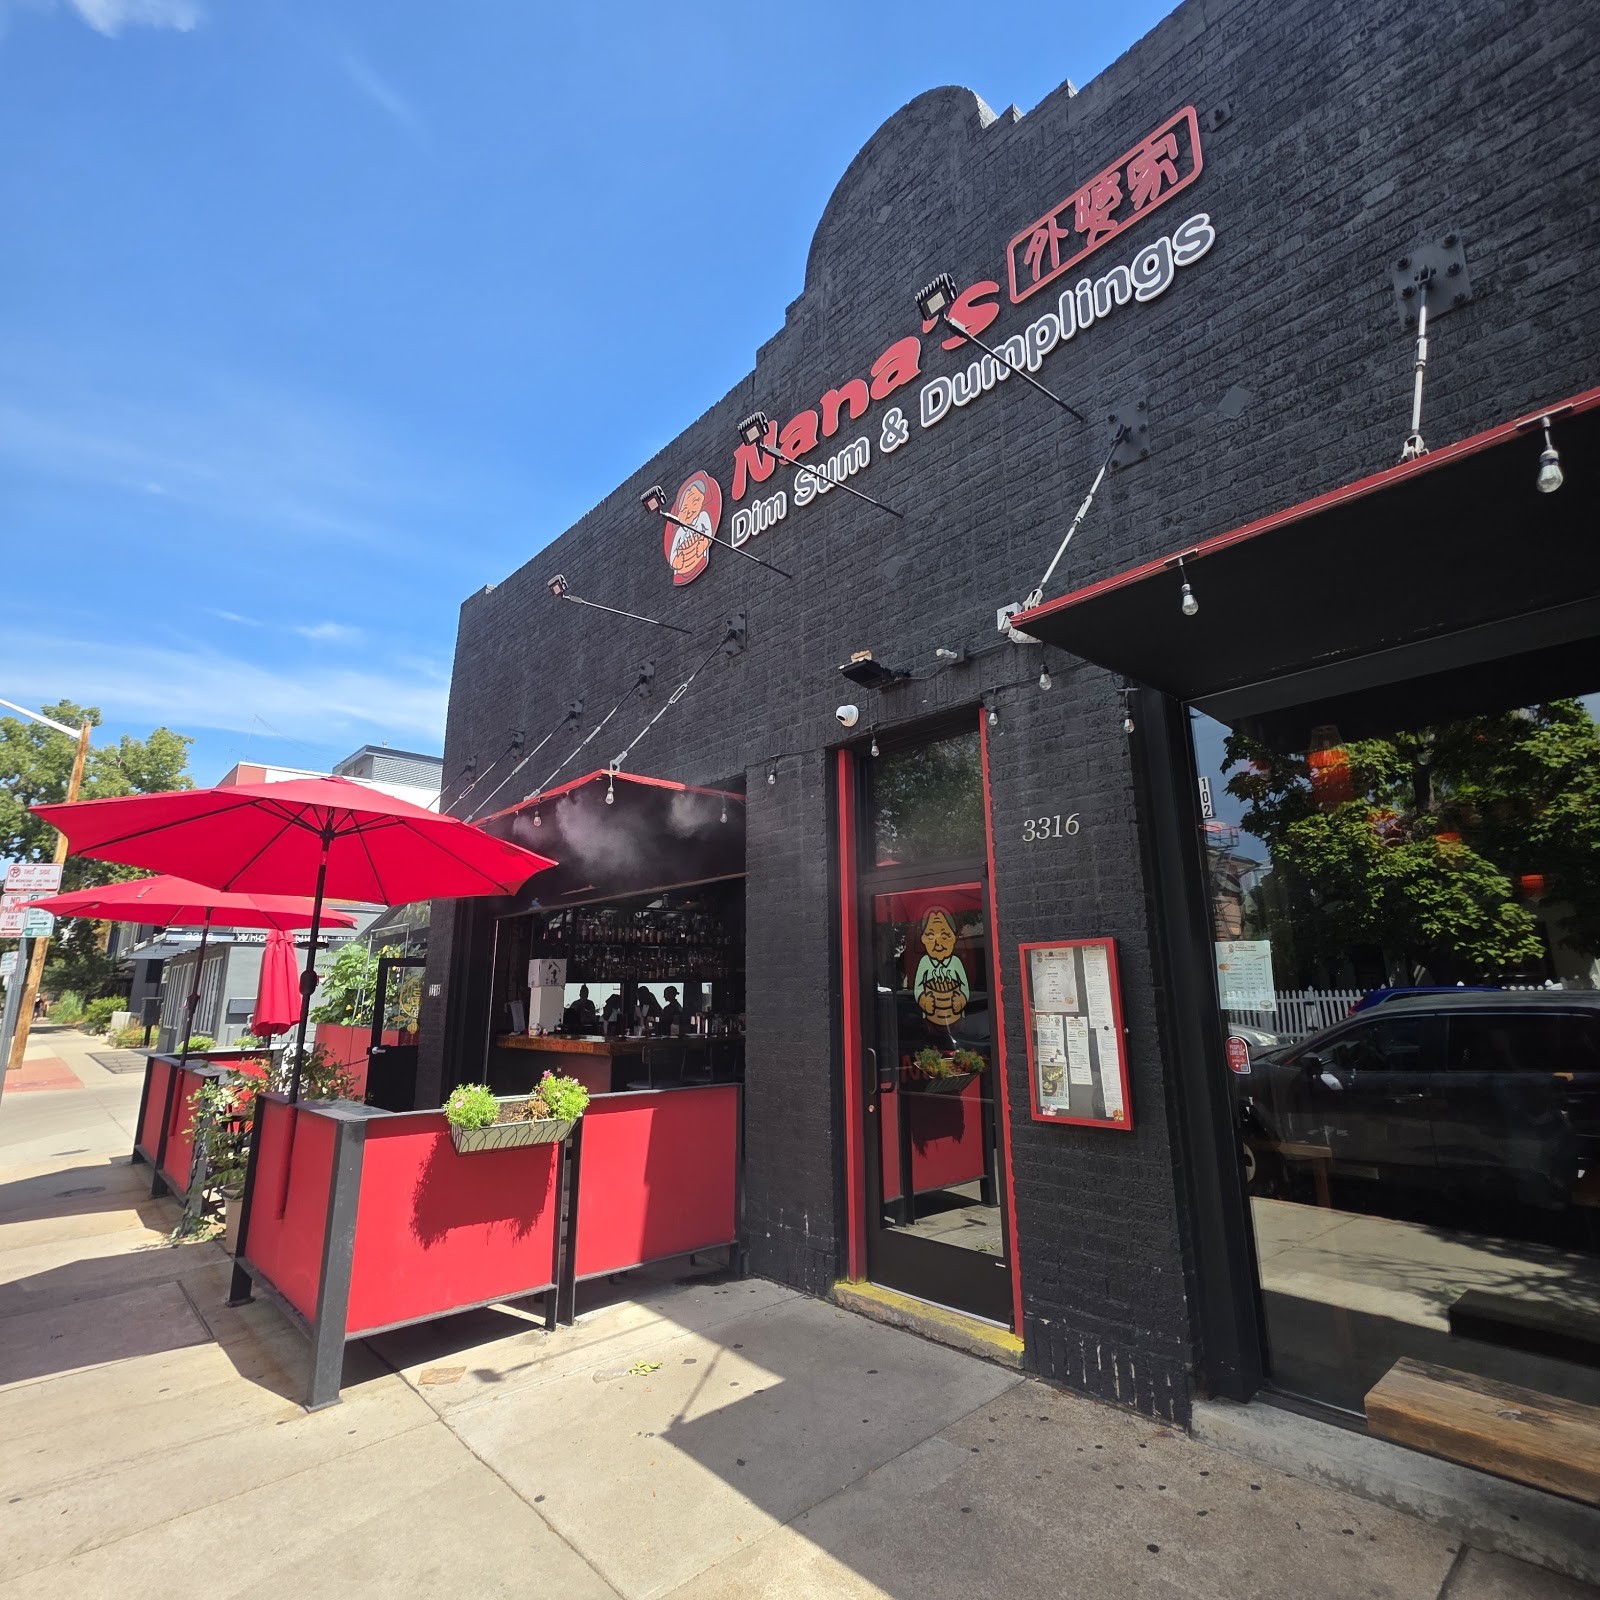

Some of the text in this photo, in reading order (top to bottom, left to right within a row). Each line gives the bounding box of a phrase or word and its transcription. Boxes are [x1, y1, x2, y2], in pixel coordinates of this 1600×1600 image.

[1024, 132, 1178, 282] 外婆家
[731, 213, 1216, 548] Dim Sum & Dumplings
[732, 281, 1000, 501] Nana's
[1022, 813, 1080, 842] 3316
[1201, 778, 1212, 817] 102
[10, 896, 21, 905] NO
